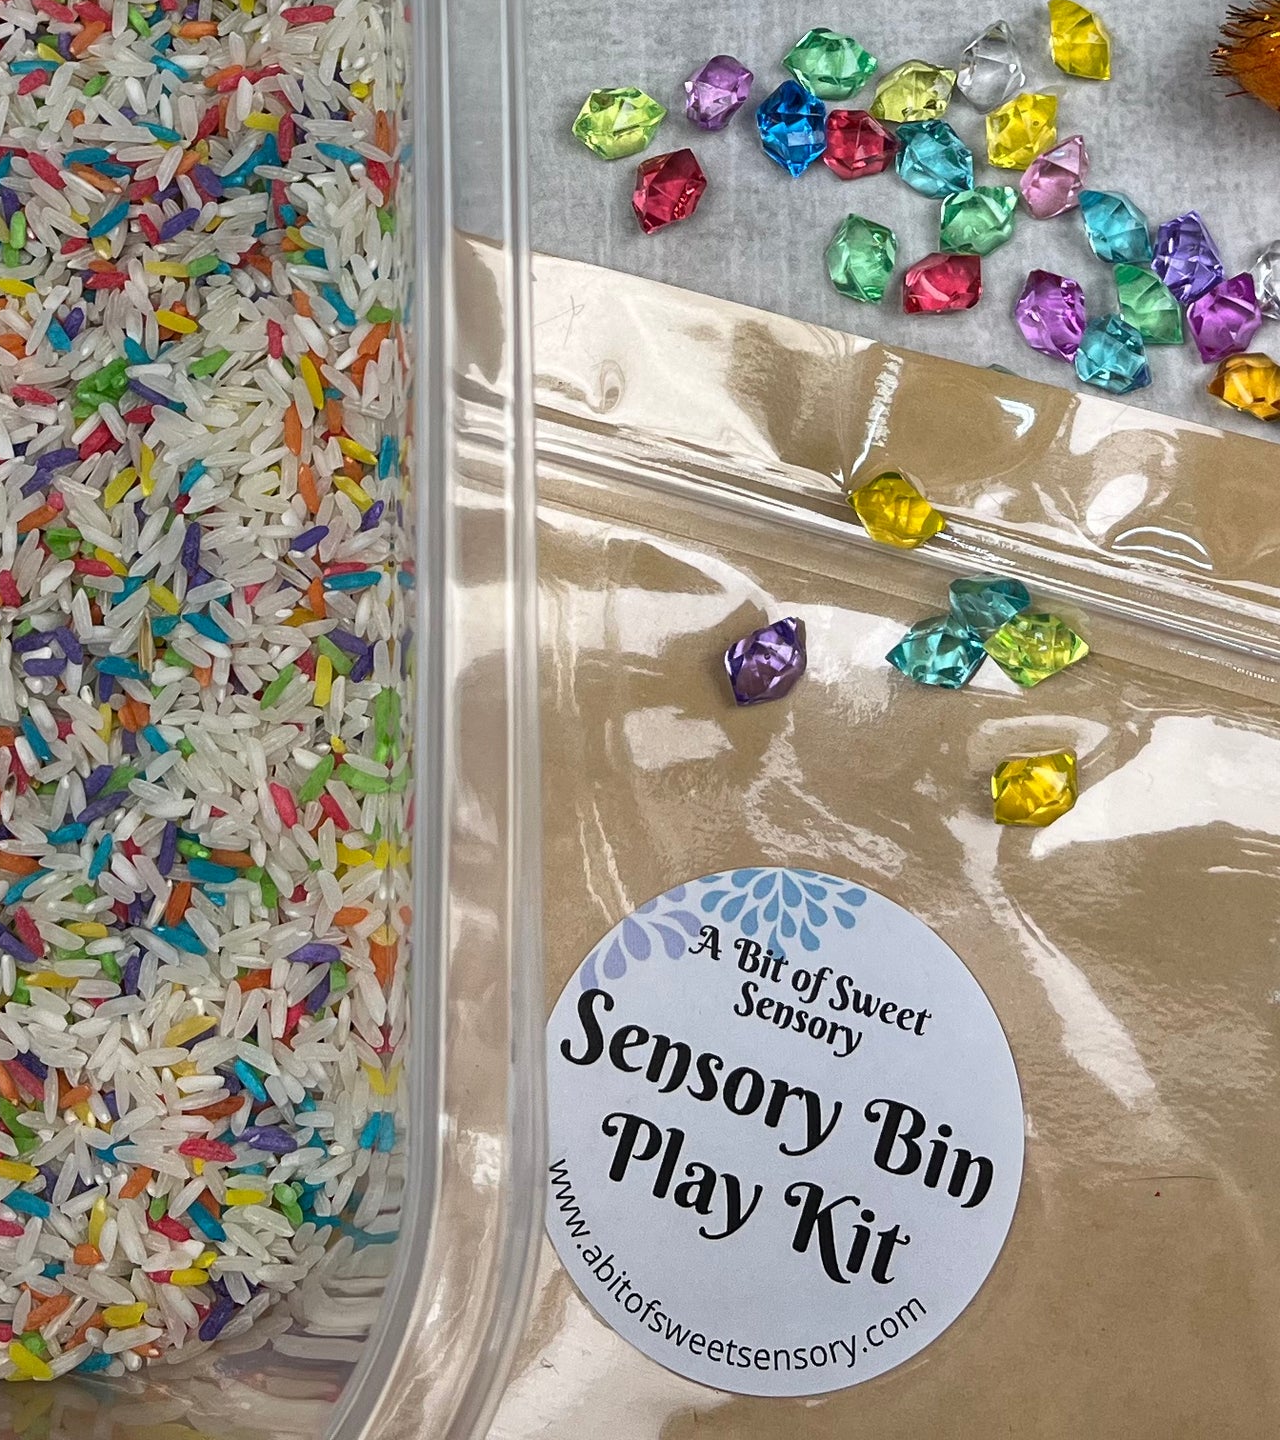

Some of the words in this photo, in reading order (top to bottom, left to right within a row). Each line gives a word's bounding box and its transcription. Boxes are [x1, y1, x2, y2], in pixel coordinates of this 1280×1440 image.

[687, 924, 724, 962] A
[732, 936, 790, 984] Bit
[791, 965, 834, 1005] of
[827, 974, 933, 1037] Sweet
[732, 979, 864, 1059] Sensory
[559, 987, 844, 1158] Sensory
[863, 1097, 995, 1210] Bin
[547, 1157, 928, 1372] www.abitofsweetsensory.com
[600, 1111, 765, 1241] Play
[783, 1180, 912, 1286] Kit
